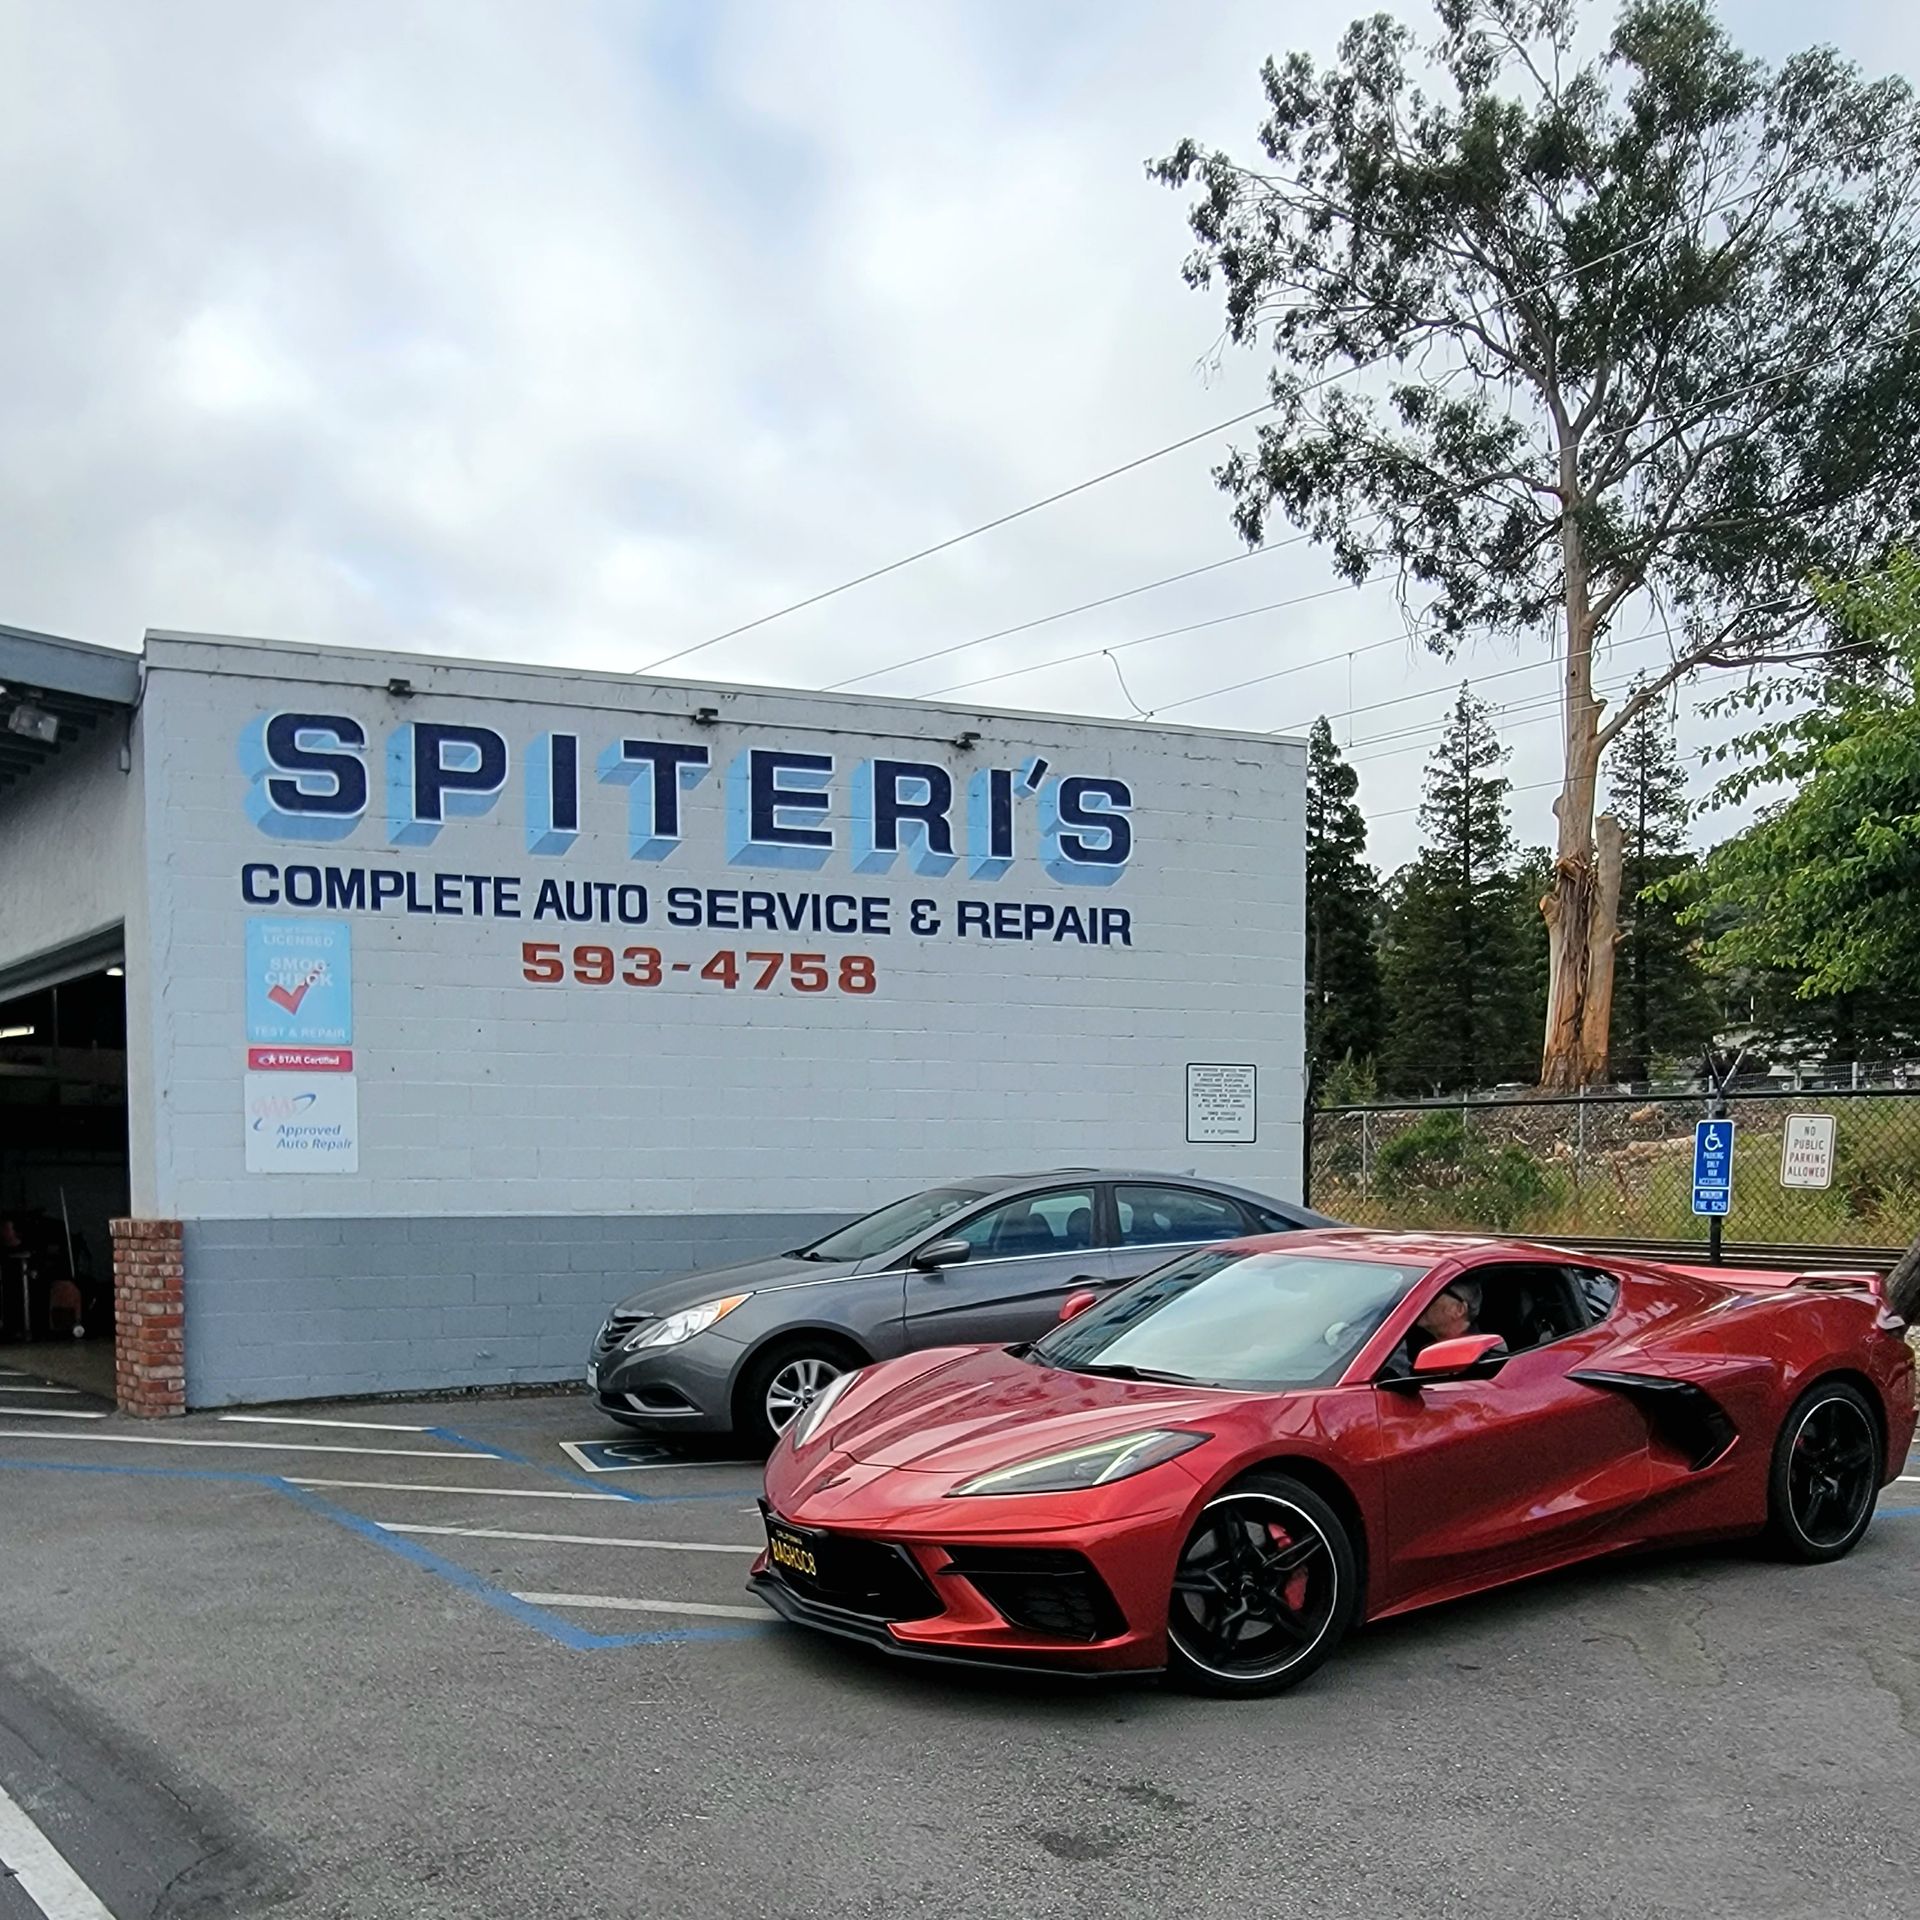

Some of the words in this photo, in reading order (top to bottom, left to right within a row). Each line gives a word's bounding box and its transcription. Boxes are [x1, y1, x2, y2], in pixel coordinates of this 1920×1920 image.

[262, 711, 1133, 868] SPITERI'S
[241, 863, 522, 920] COMPLETE
[533, 879, 649, 925] AUTO
[667, 886, 891, 935] SERVICE
[910, 898, 941, 936] &
[956, 900, 1132, 946] REPAIR
[263, 934, 334, 948] LICENSED
[270, 957, 327, 973] SMOG
[522, 941, 877, 995] 593-4758
[264, 971, 334, 988] CHECK
[255, 1025, 285, 1038] TEST
[301, 1027, 346, 1039] REPAIR
[278, 1055, 302, 1064] STAR
[304, 1055, 340, 1065] Certified
[277, 1124, 342, 1137] Approved
[1804, 1126, 1817, 1137] NO
[276, 1138, 309, 1149] Auto
[312, 1139, 353, 1151] Repair
[1794, 1138, 1825, 1150] PUBLIC
[1789, 1152, 1826, 1164] PARKING
[1787, 1166, 1826, 1178] ALLOWED
